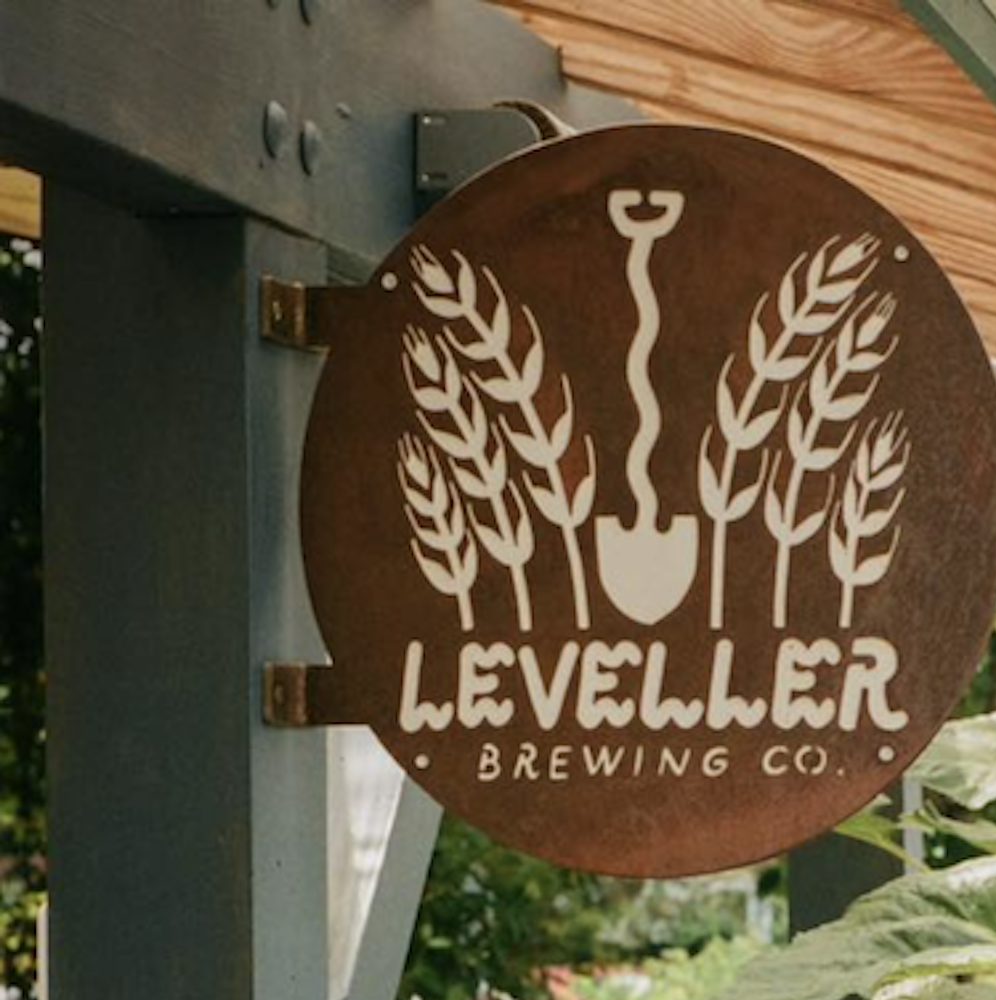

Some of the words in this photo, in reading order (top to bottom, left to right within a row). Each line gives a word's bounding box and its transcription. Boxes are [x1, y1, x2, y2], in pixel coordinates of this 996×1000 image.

[400, 638, 909, 732] LEVELLER
[477, 743, 730, 781] BREWING
[762, 745, 845, 777] CO.
